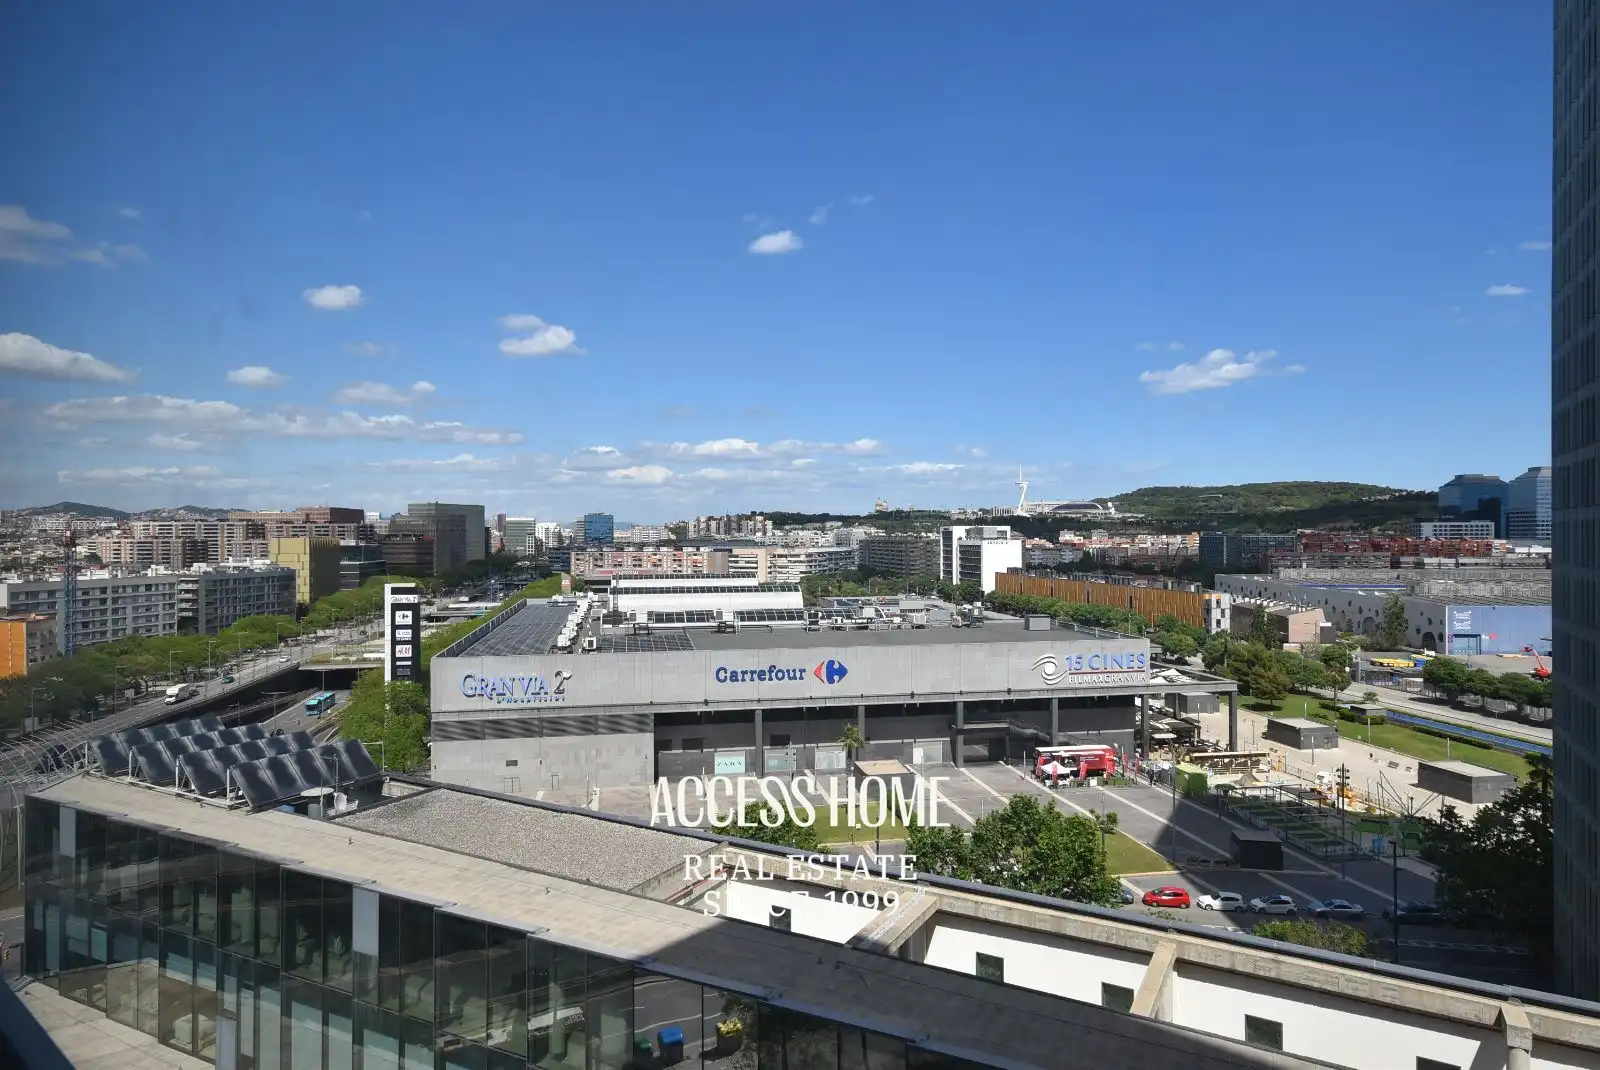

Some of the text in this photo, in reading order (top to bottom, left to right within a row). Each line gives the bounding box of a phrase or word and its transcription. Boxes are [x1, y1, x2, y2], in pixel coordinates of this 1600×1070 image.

[1065, 653, 1146, 671] 15 CINES
[554, 670, 573, 695] 2
[715, 665, 807, 684] Carrefour
